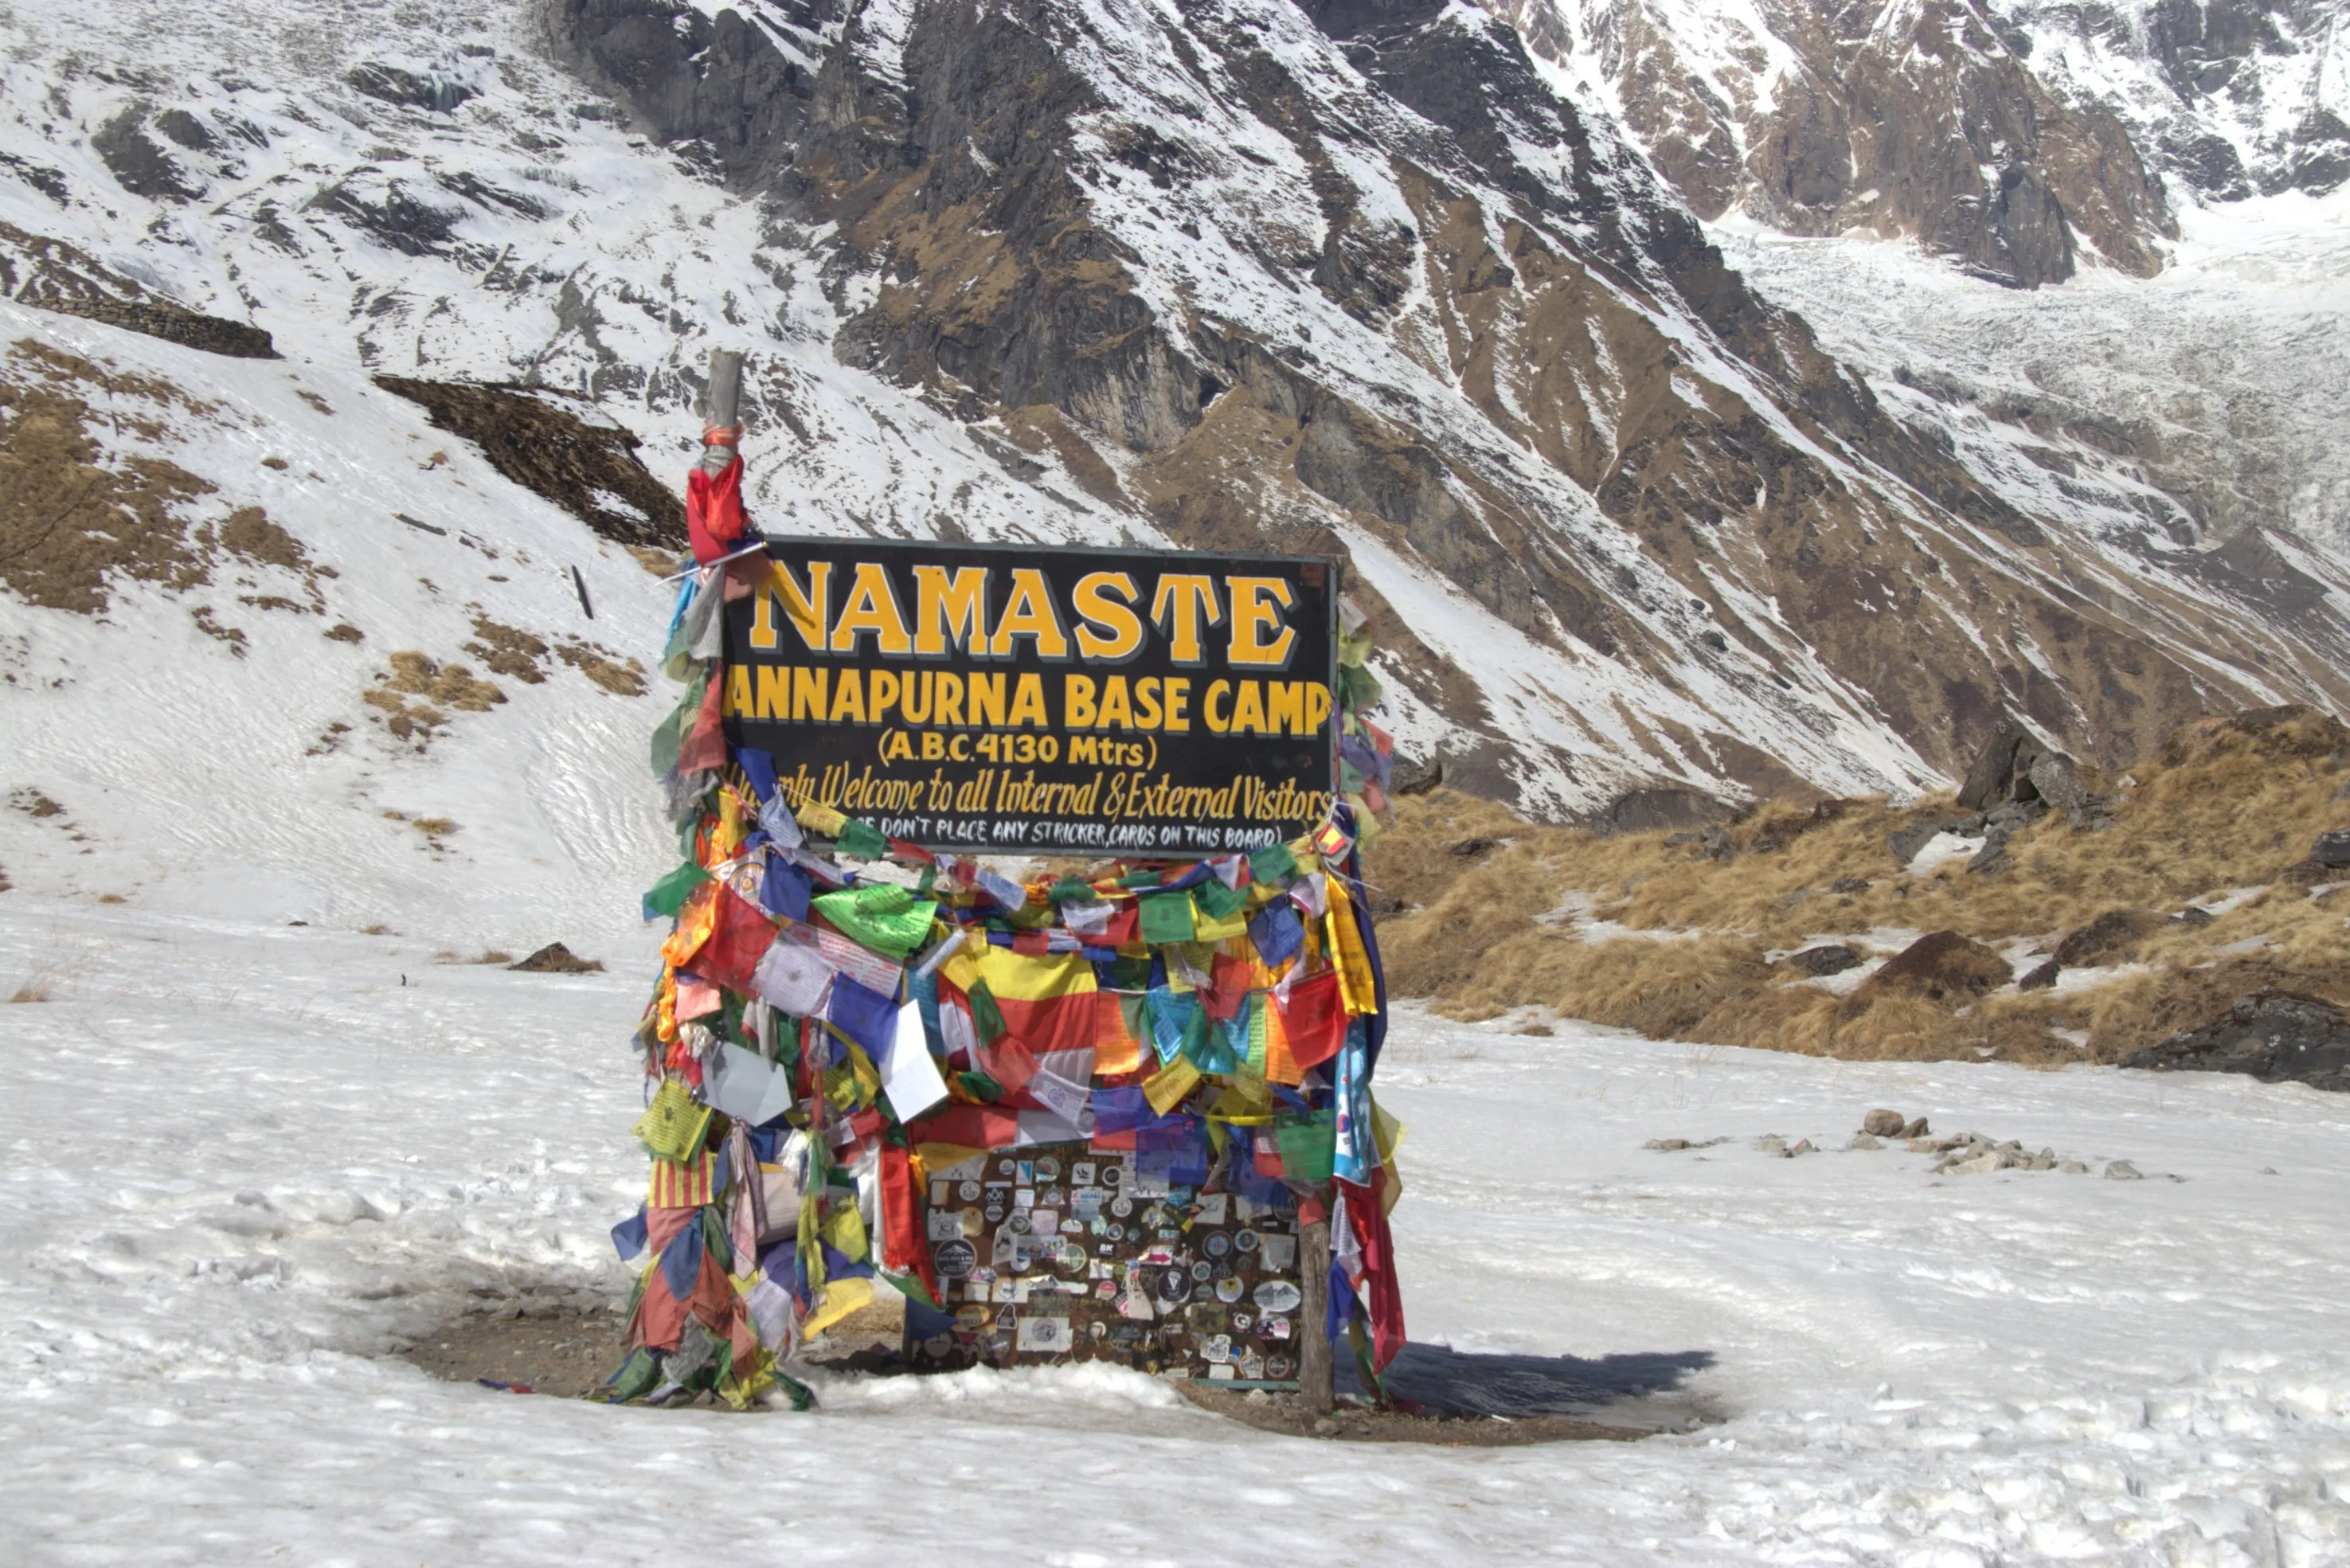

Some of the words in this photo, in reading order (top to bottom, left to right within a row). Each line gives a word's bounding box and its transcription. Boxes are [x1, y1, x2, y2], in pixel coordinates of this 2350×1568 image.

[749, 560, 1296, 666] NAMASTE
[722, 663, 1048, 729] ANNAPURNA
[1065, 674, 1191, 733] BASE
[1204, 678, 1332, 736] CAMP
[1068, 735, 1157, 770] Mtrs)
[820, 761, 925, 815] Welcome
[928, 767, 953, 812] to
[956, 768, 995, 813] all
[995, 768, 1103, 815] Internal
[1124, 772, 1242, 823] External
[1245, 774, 1331, 821] Visitors
[881, 816, 932, 839] DON'T
[936, 819, 988, 844] PLACE
[993, 821, 1029, 843] ANY
[1184, 826, 1221, 847] THIS
[1225, 826, 1282, 849] BOARD)
